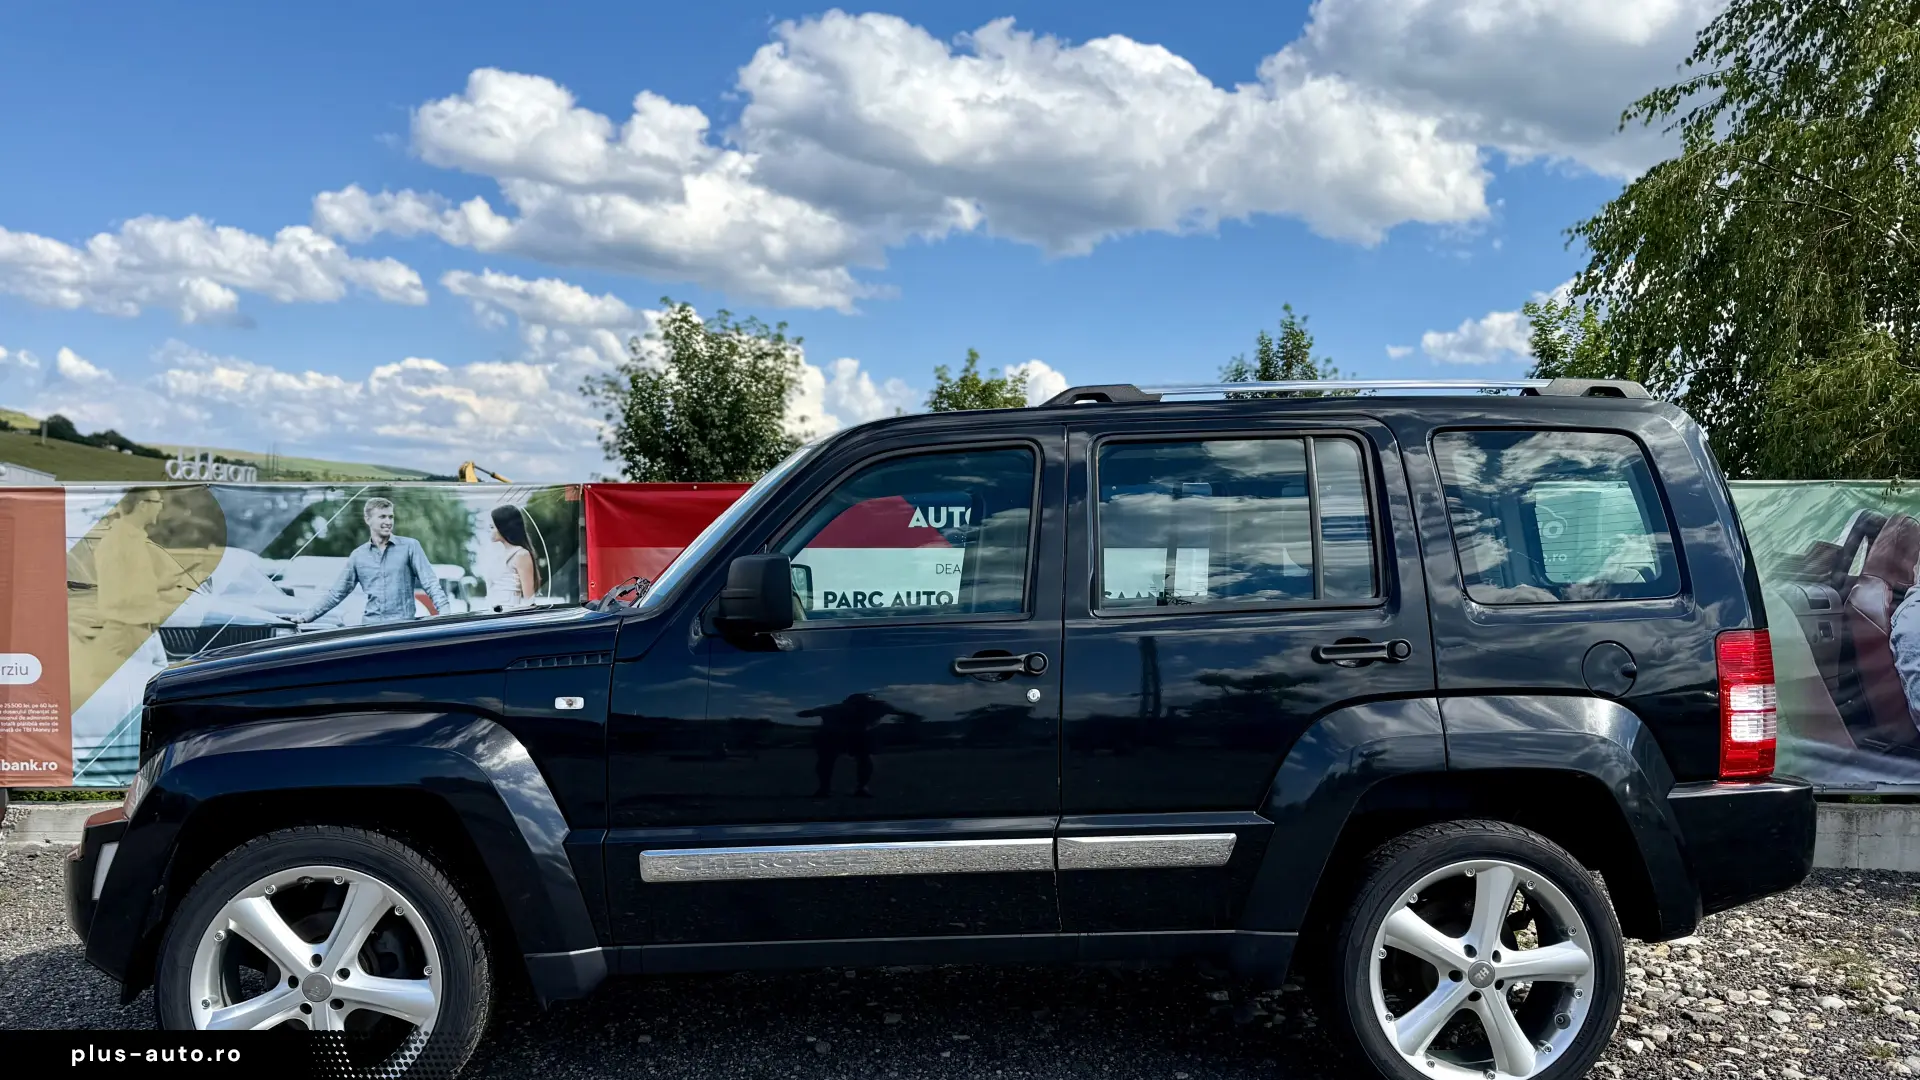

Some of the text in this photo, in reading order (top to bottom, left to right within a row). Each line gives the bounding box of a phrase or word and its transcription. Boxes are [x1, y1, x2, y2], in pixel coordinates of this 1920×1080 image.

[823, 591, 954, 608] PARC AUTO
[675, 856, 869, 871] CHEROKEE
